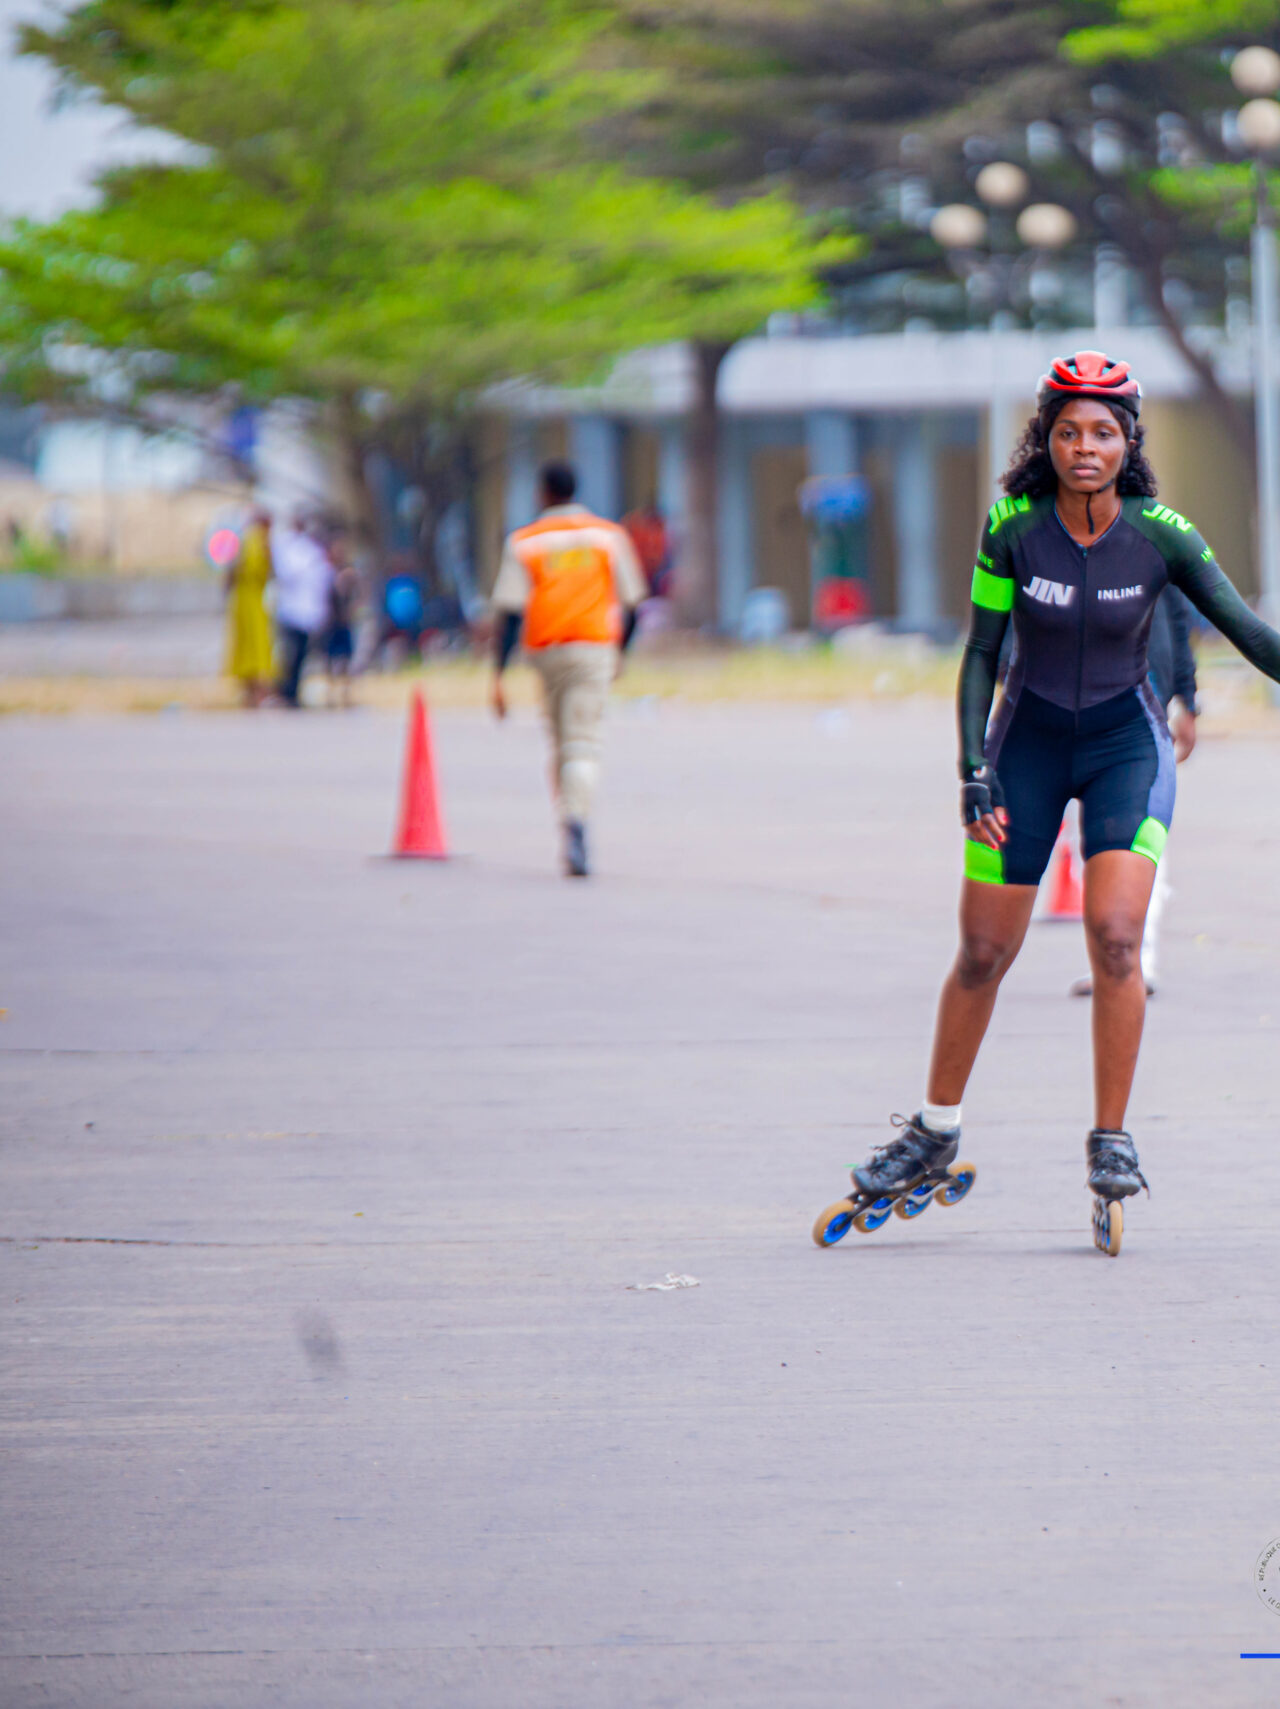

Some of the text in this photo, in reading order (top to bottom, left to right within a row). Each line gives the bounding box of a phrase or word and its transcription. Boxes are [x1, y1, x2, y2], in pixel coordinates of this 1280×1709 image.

[1141, 503, 1193, 533] JIN
[1022, 576, 1075, 606] JIN
[1097, 584, 1143, 601] INLINE
